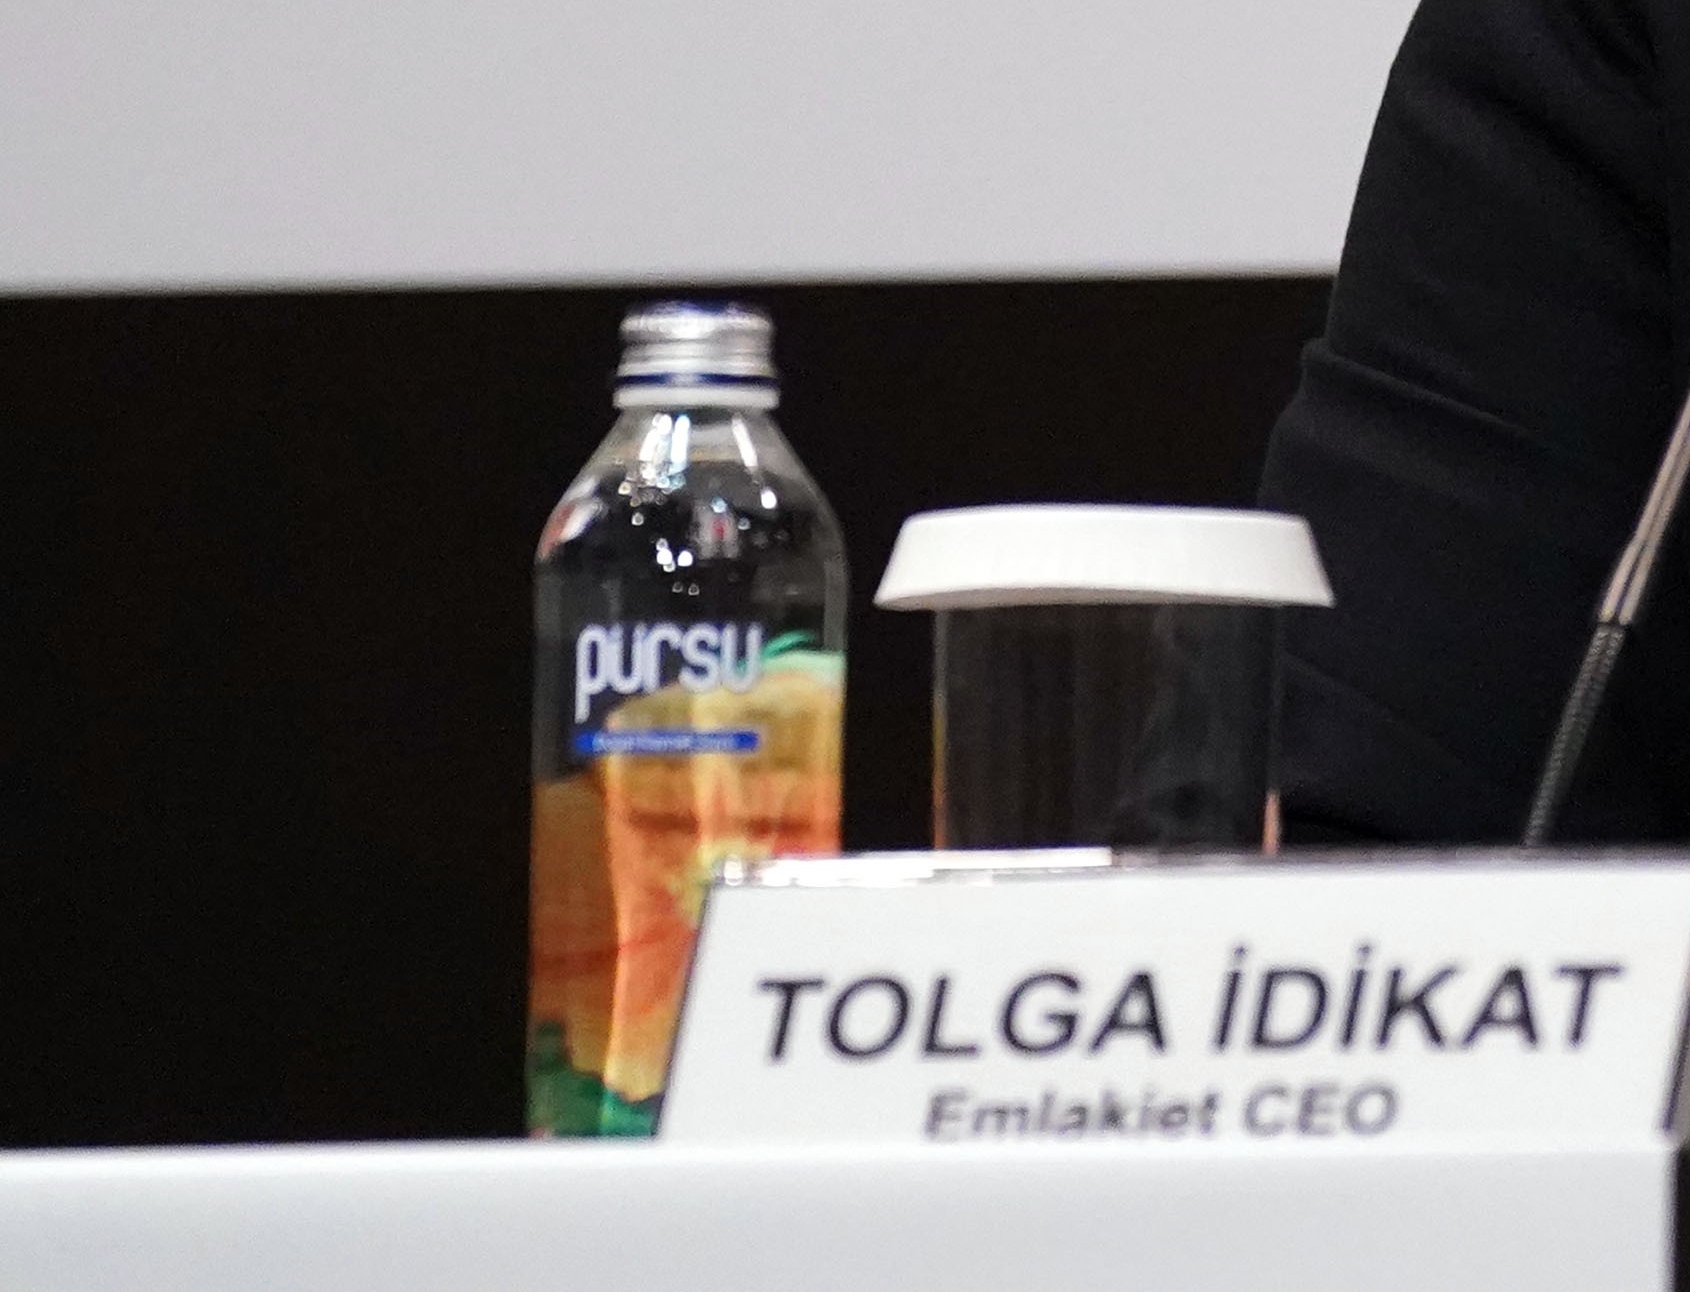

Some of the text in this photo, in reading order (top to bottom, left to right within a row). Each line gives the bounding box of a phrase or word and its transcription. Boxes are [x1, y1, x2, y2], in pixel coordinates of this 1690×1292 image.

[574, 622, 764, 724] pursu
[756, 941, 1625, 1063] TOLGA İDİKAT
[1242, 1081, 1400, 1138] CEO
